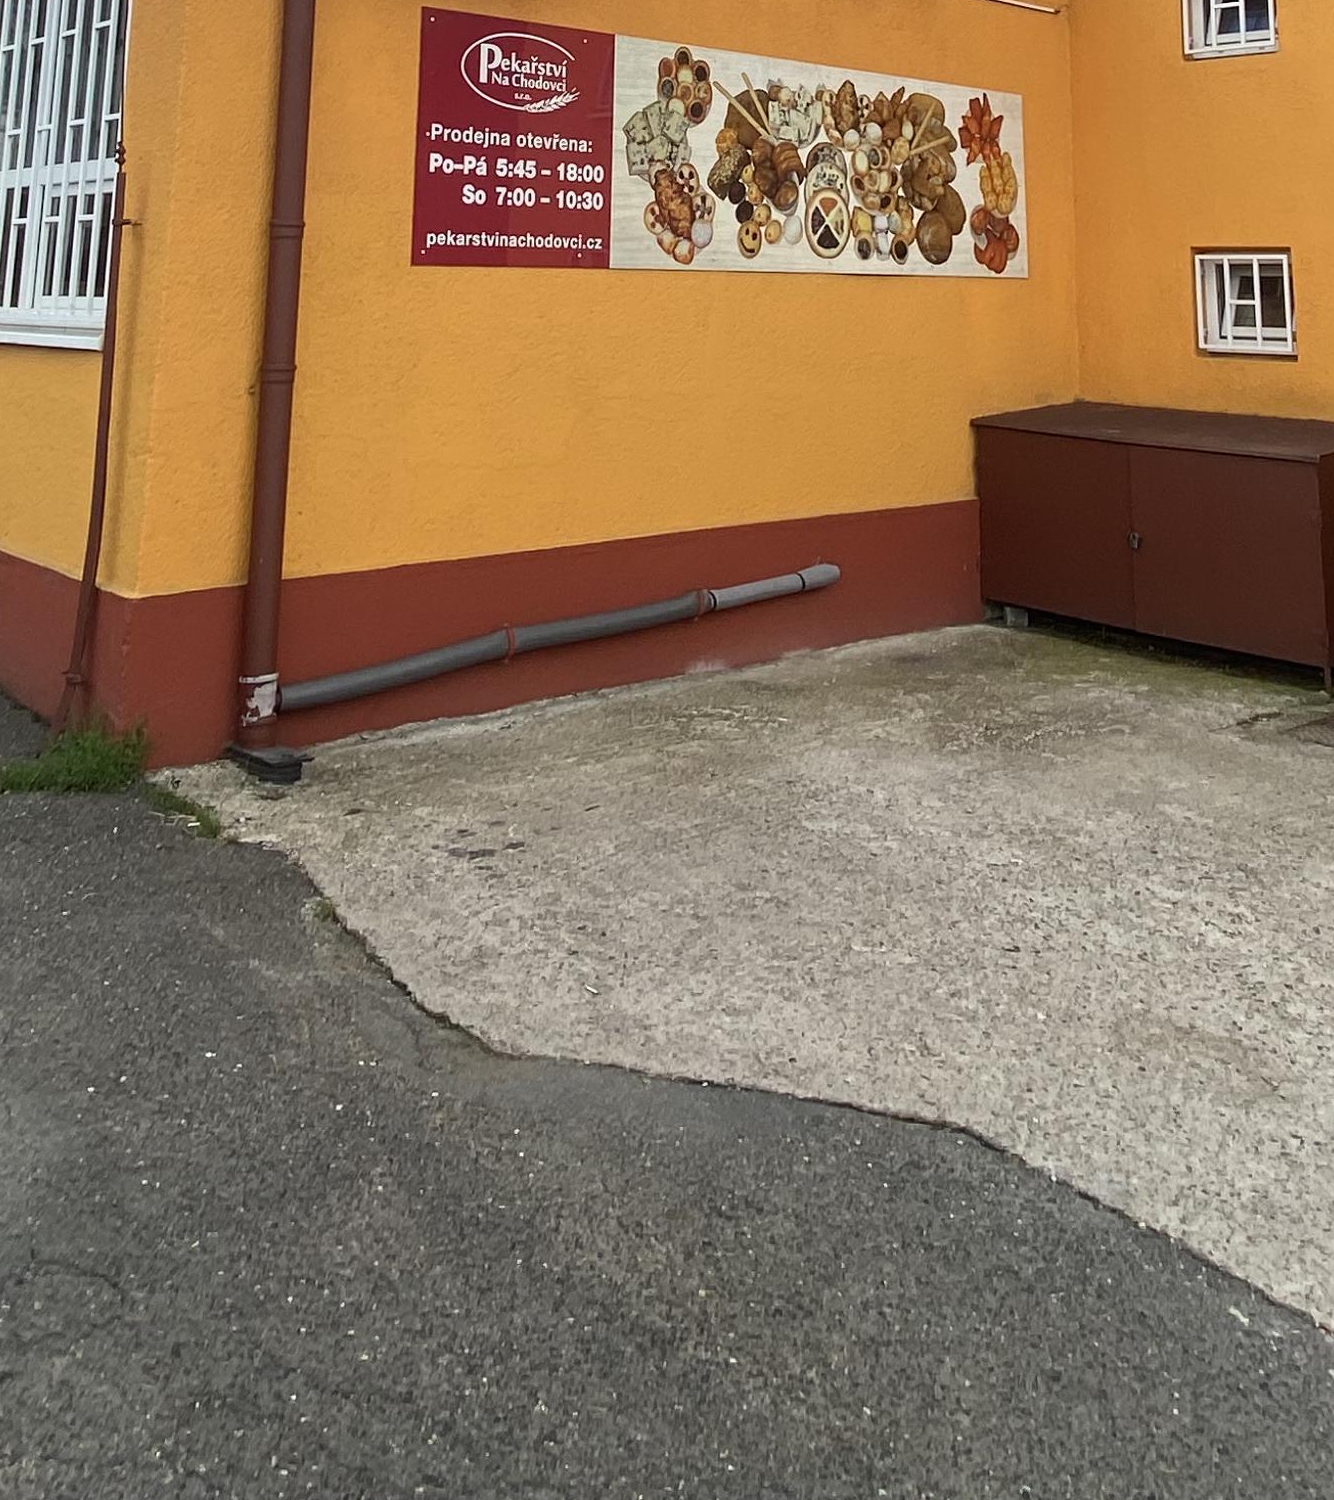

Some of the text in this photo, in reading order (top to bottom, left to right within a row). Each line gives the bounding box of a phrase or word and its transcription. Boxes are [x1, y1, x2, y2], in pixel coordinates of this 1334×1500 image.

[479, 43, 567, 83] Pekařství
[491, 72, 567, 92] Na Chodovci
[430, 123, 593, 153] Prodejna otevřena:
[495, 158, 537, 179] 5:45
[557, 163, 605, 183] 18:00
[462, 184, 487, 205] So
[495, 187, 536, 207] 7:00
[556, 191, 604, 210] 10:30
[426, 230, 603, 250] pekarstvinachodovci.cz
